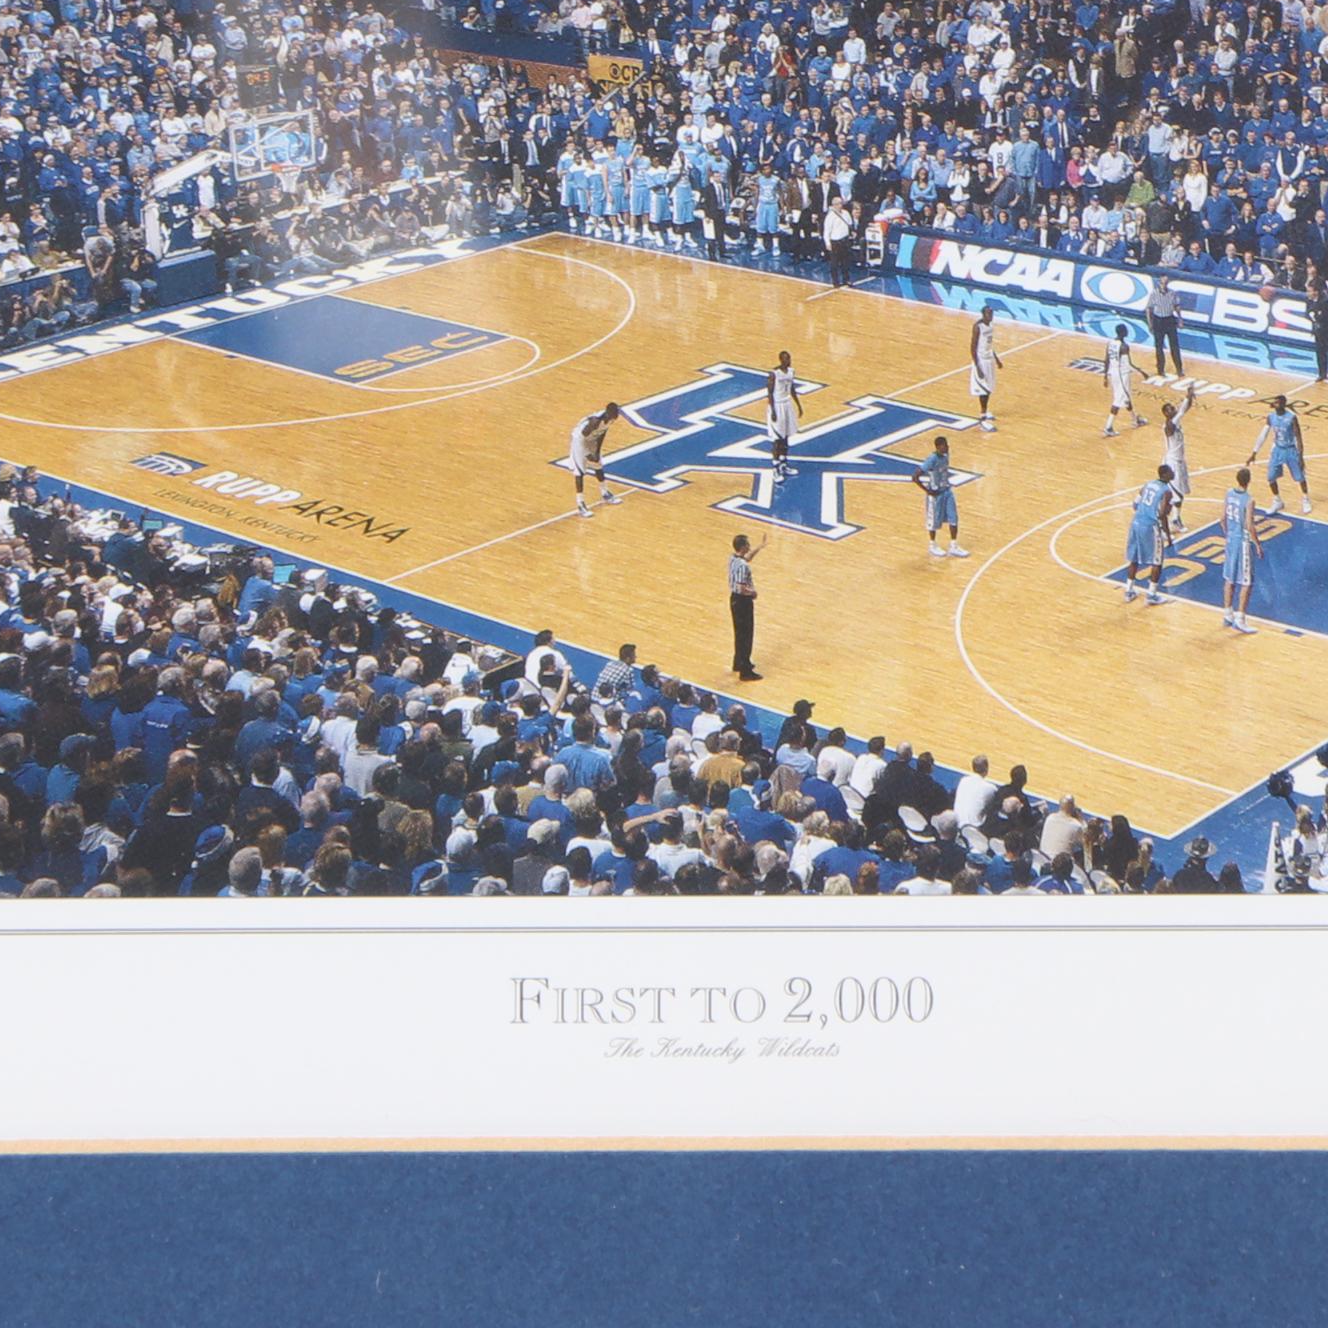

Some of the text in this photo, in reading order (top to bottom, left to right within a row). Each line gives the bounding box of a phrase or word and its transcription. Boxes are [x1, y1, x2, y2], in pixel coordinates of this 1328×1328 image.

[932, 240, 1316, 343] NCAA CBS
[334, 331, 490, 380] SEC
[1142, 373, 1256, 400] RUPP
[549, 361, 984, 541] UK
[192, 470, 412, 543] RUPP ARENA
[1142, 487, 1155, 506] 13
[1225, 502, 1240, 522] 44
[238, 515, 322, 544] KENTUCKY
[509, 975, 935, 1030] FIRST TO 2,000
[604, 1036, 841, 1065] The Kentucky Wildcats
